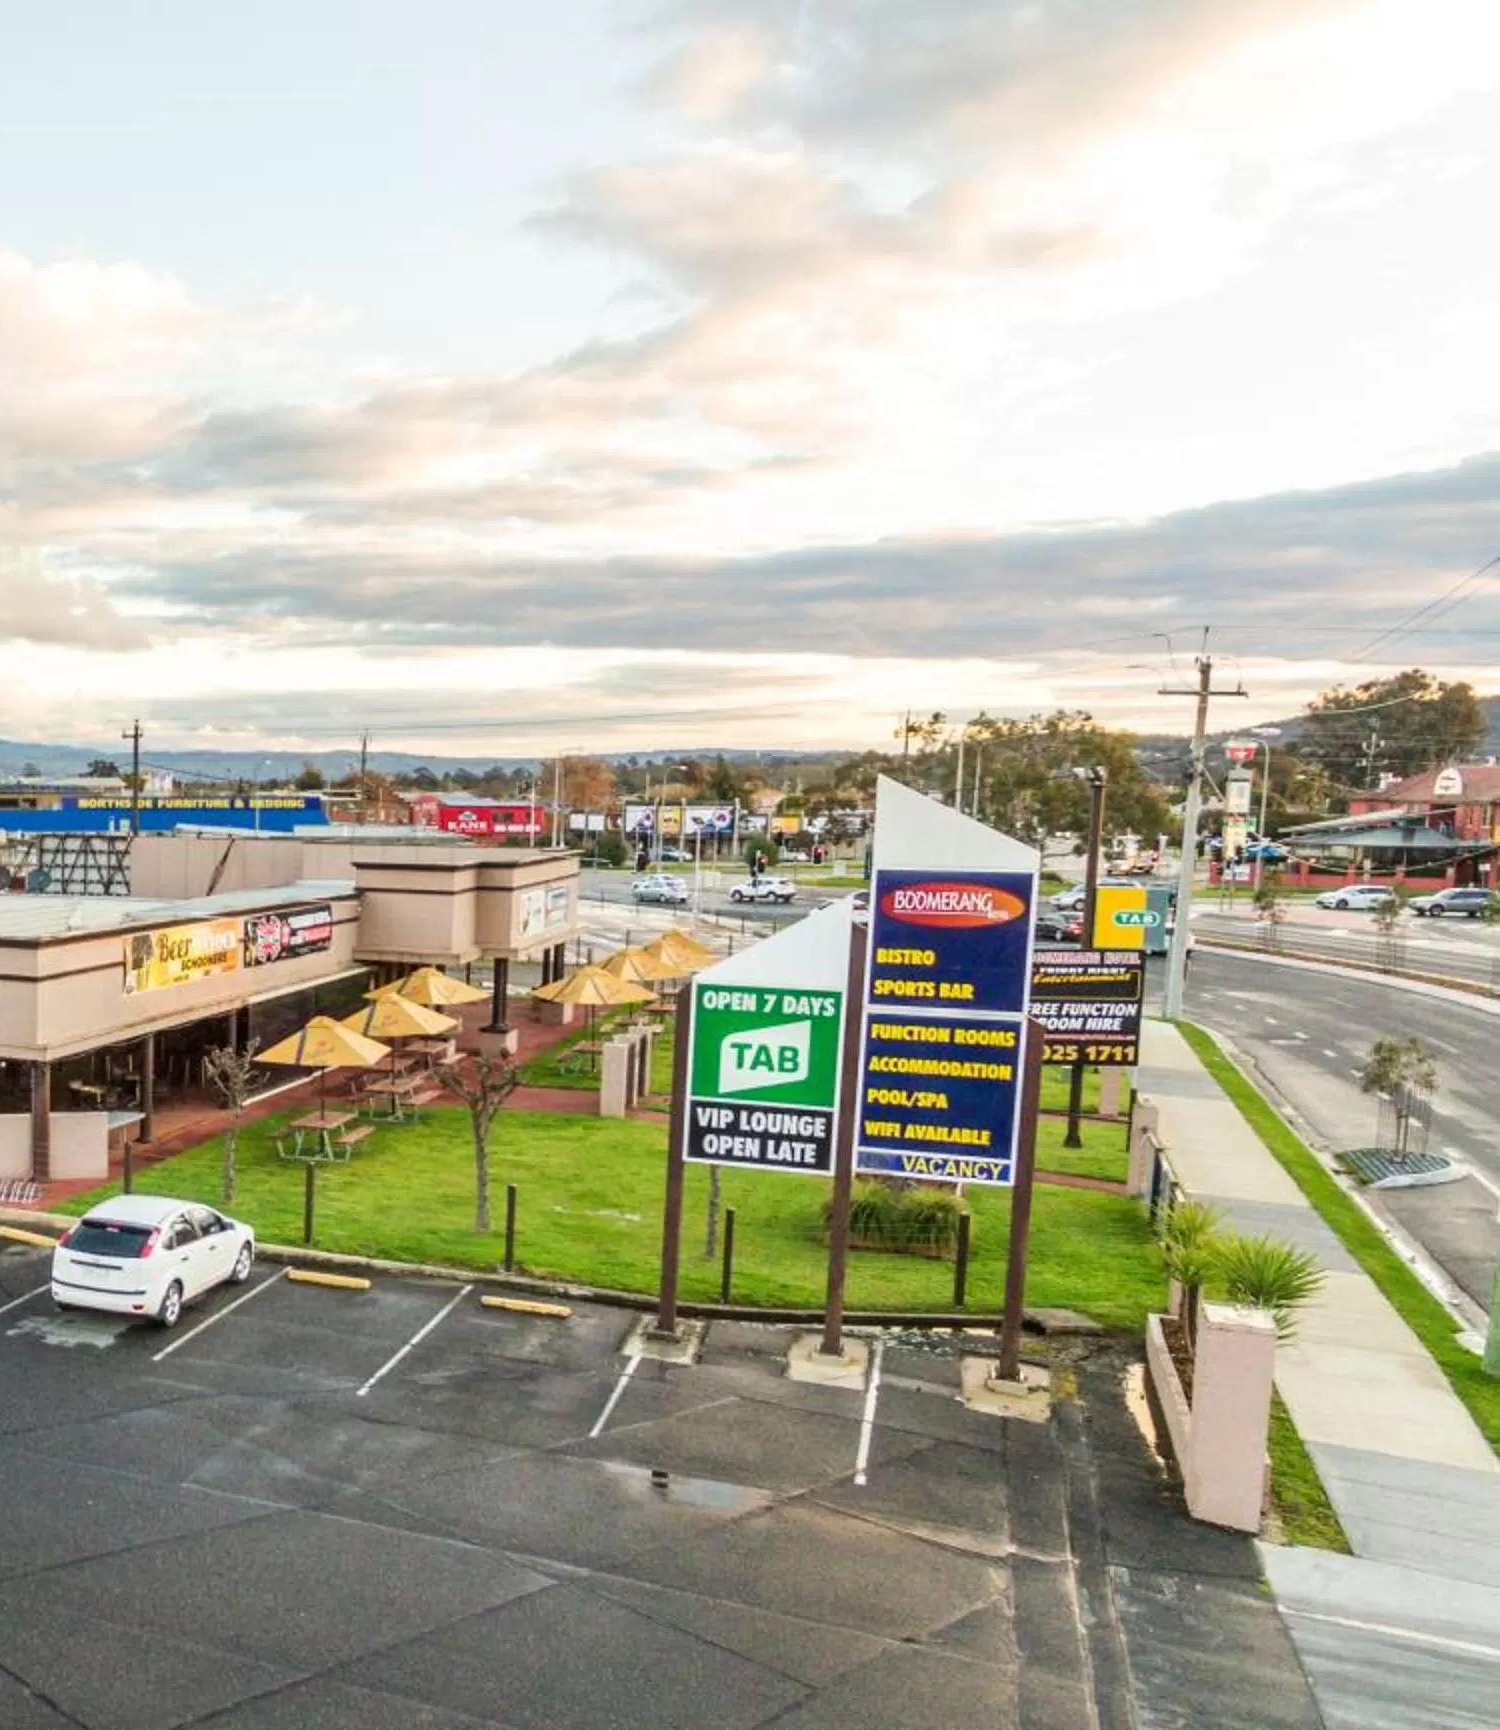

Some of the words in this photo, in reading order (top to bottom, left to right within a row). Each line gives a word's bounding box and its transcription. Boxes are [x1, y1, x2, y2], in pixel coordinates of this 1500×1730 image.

[78, 798, 152, 809] NORTHSDE
[157, 798, 229, 809] FURNITURE
[893, 889, 994, 912] BOOMERANG
[1120, 913, 1154, 924] TAB
[158, 932, 193, 963] Beer
[875, 947, 936, 966] BISTRO
[873, 978, 936, 997] SPORTS
[939, 983, 975, 1000] BAR
[702, 990, 757, 1012] OPEN
[763, 993, 777, 1013] 7
[782, 995, 836, 1017] DAYS
[1061, 1003, 1139, 1017] FUNCTION
[870, 1023, 950, 1043] FUNCTION
[954, 1029, 1016, 1048] ROOMS
[1085, 1017, 1124, 1031] HIRE
[729, 1042, 800, 1073] TAB
[1086, 1045, 1137, 1062] 1711
[868, 1055, 1013, 1081] ACCOMMODATION
[867, 1088, 949, 1109] POOL/SPA
[696, 1107, 735, 1129] VIP
[739, 1110, 827, 1138] LOUNGE
[864, 1120, 901, 1138] WIFI
[904, 1124, 992, 1146] AVAILABLE
[702, 1134, 761, 1159] OPEN
[766, 1139, 817, 1164] LATE
[902, 1155, 1004, 1180] VACANCY
